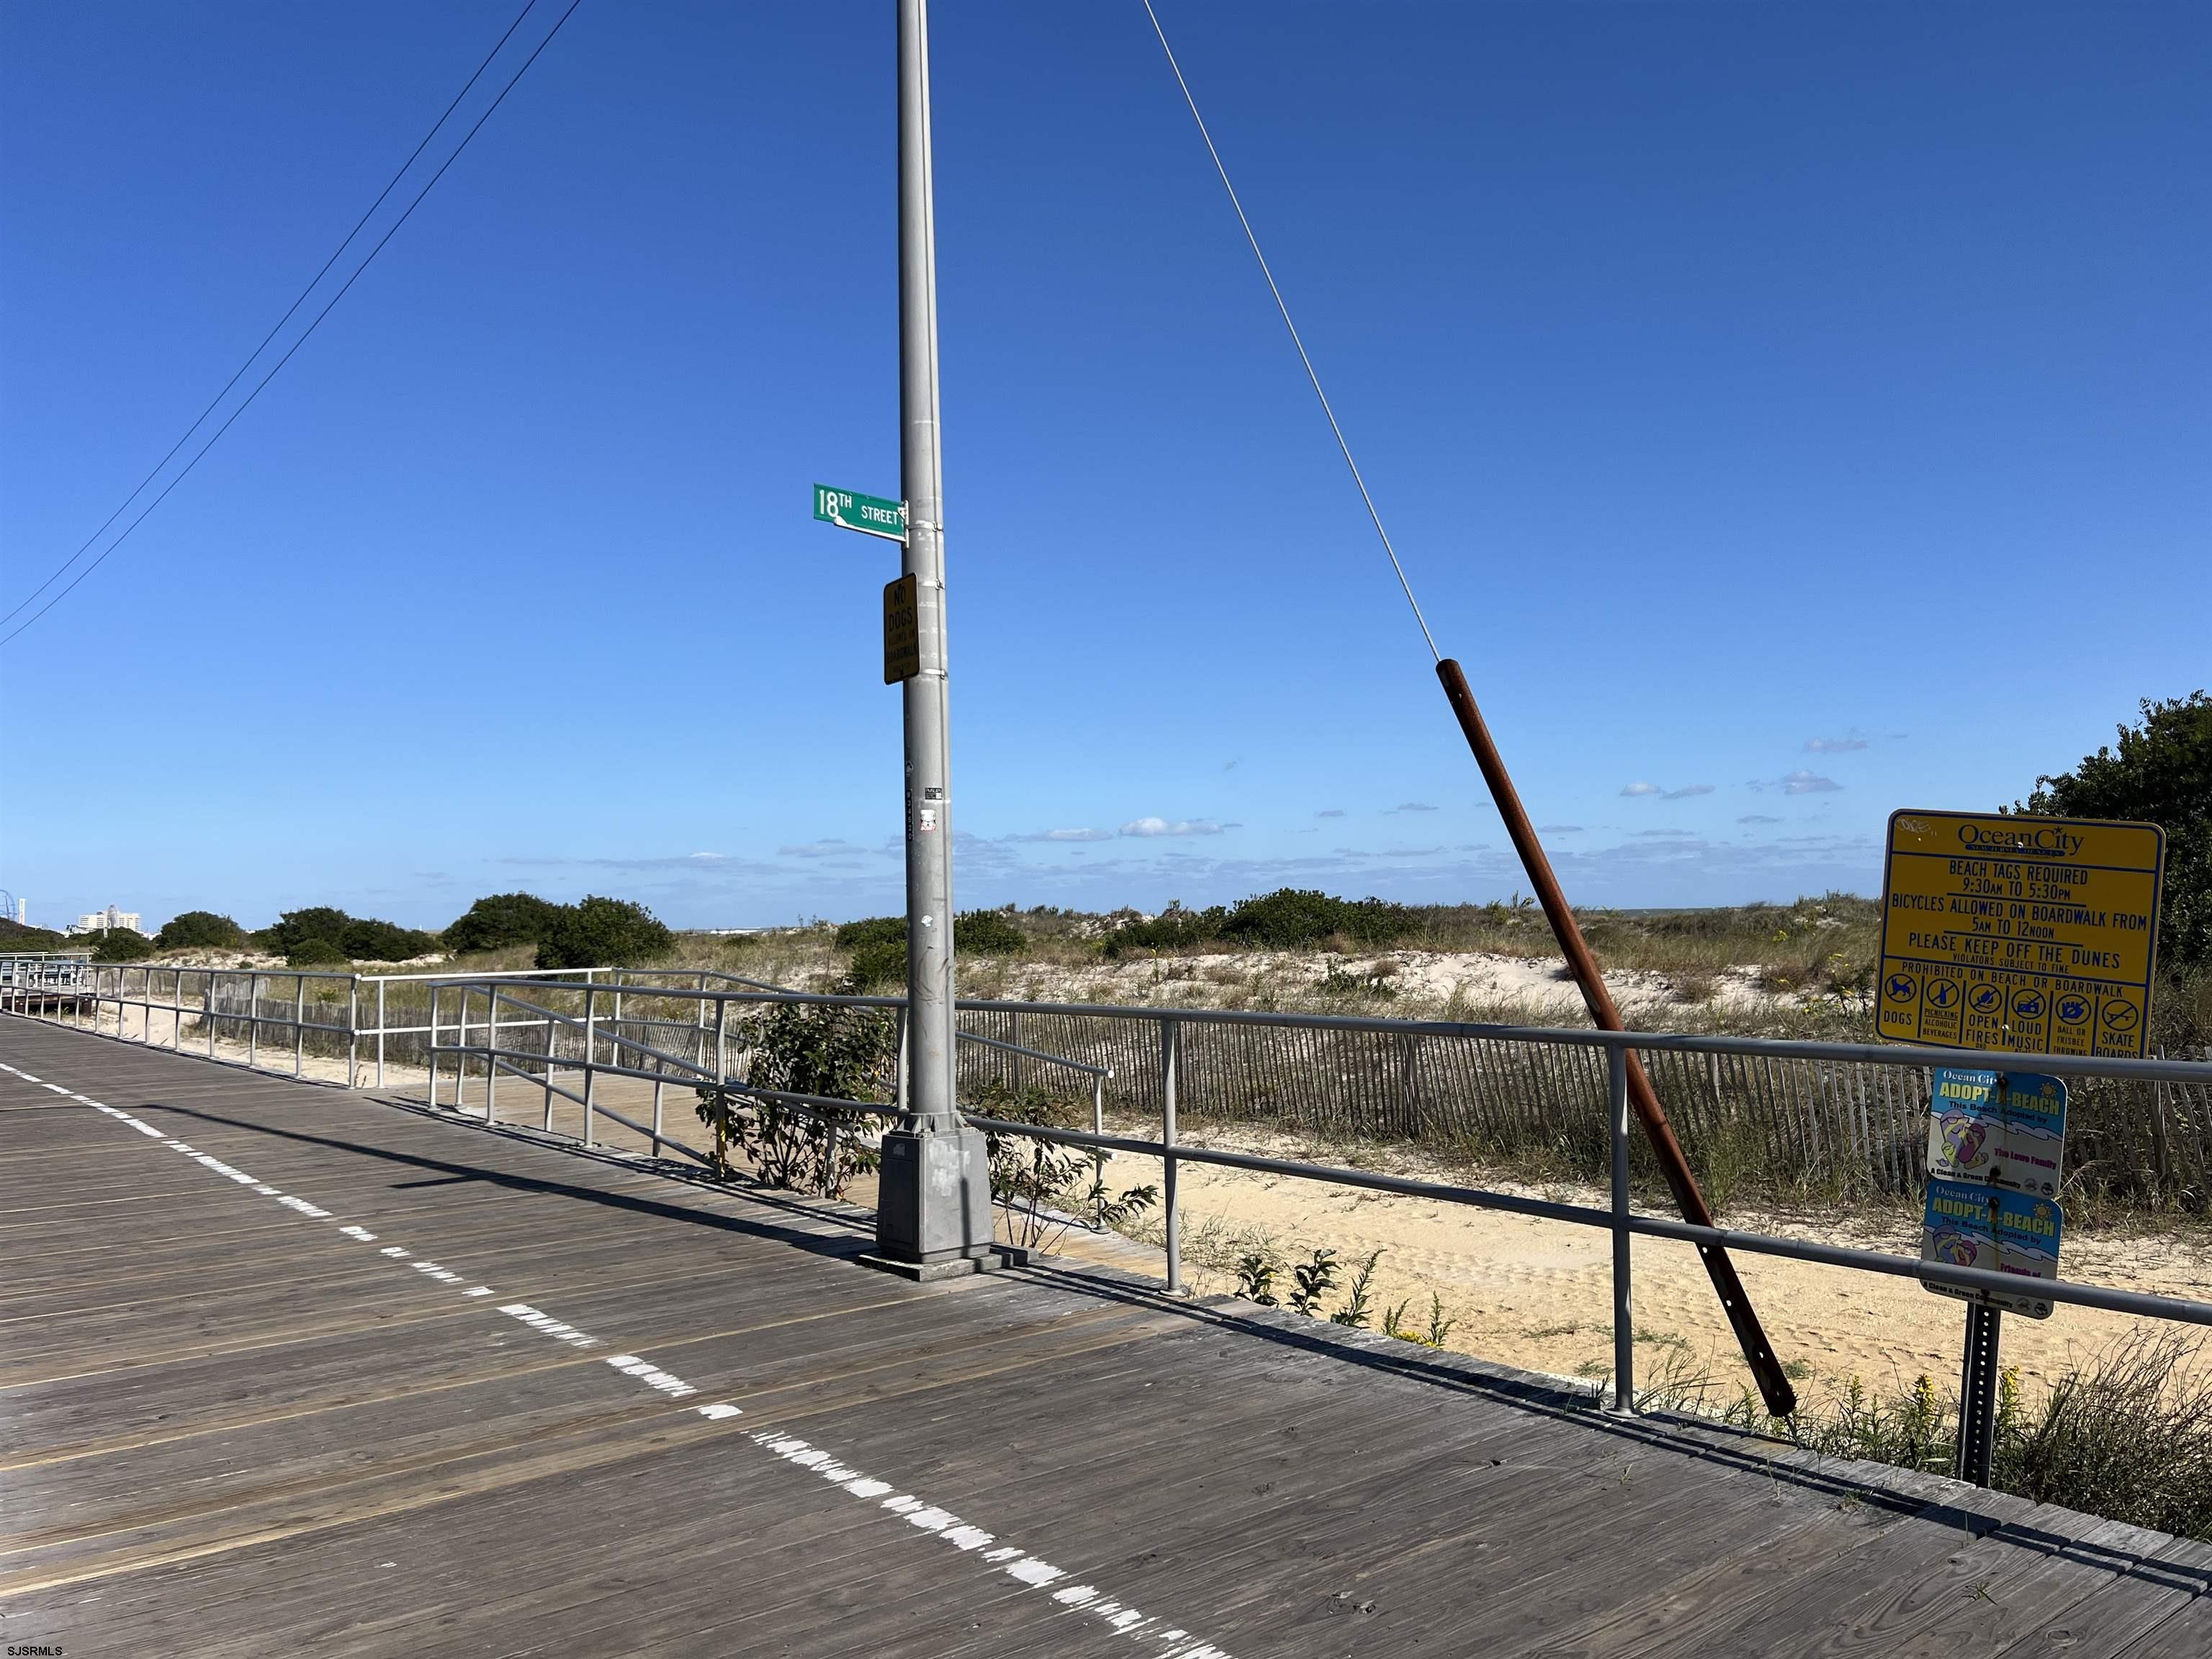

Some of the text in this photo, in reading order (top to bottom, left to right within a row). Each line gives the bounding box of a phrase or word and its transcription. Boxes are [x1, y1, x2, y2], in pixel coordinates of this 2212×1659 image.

[861, 506, 898, 524] STREET
[894, 585, 906, 605] NO
[889, 607, 912, 632] DOGS
[1949, 860, 2088, 885] BEACH TAGS REQUIRED
[1963, 878, 2070, 900] 9:30AM TO 5:30PM
[1892, 894, 2147, 930] BICYCLES ALLOWED ON BOARDWALK FROM
[1972, 917, 2054, 939] 5AM TO 12NOON
[1909, 933, 2120, 969] PLEASE KEEP OFF THE DUNES
[1953, 953, 2069, 974] VIOLATORS SUBJECT TO FINE
[1902, 962, 2123, 997] PROHIBITED ON BEACH OR BOARDWALK
[1884, 1011, 1912, 1025] DOGS
[1925, 1008, 1959, 1020] PICNICKING
[1969, 1014, 1999, 1028] OPEN
[1924, 1019, 1957, 1029] ALCOHOLIC
[2012, 1020, 2042, 1035] LOUD
[2057, 1026, 2073, 1035] BALL
[1923, 1028, 1957, 1039] BEVERAGES
[1966, 1029, 1999, 1046] FIRES
[2057, 1037, 2085, 1046] FRISBEE
[2102, 1031, 2134, 1048] SKATE
[2008, 1035, 2044, 1051] MUSIC
[2054, 1046, 2087, 1056] THROWING
[2096, 1046, 2138, 1058] BOARDS
[1943, 1070, 1976, 1082] Ocean
[1948, 1101, 2048, 1124] This Beach Adopted by
[1994, 1147, 2008, 1157] The
[2031, 1155, 2056, 1170] Family
[1937, 1169, 1954, 1177] Clean
[1963, 1172, 1983, 1181] Green
[1936, 1185, 1969, 1199] Ocean
[1942, 1216, 2041, 1245] This Beach Adopted by
[1928, 1282, 1947, 1292] Clean
[1954, 1287, 1974, 1297] Green
